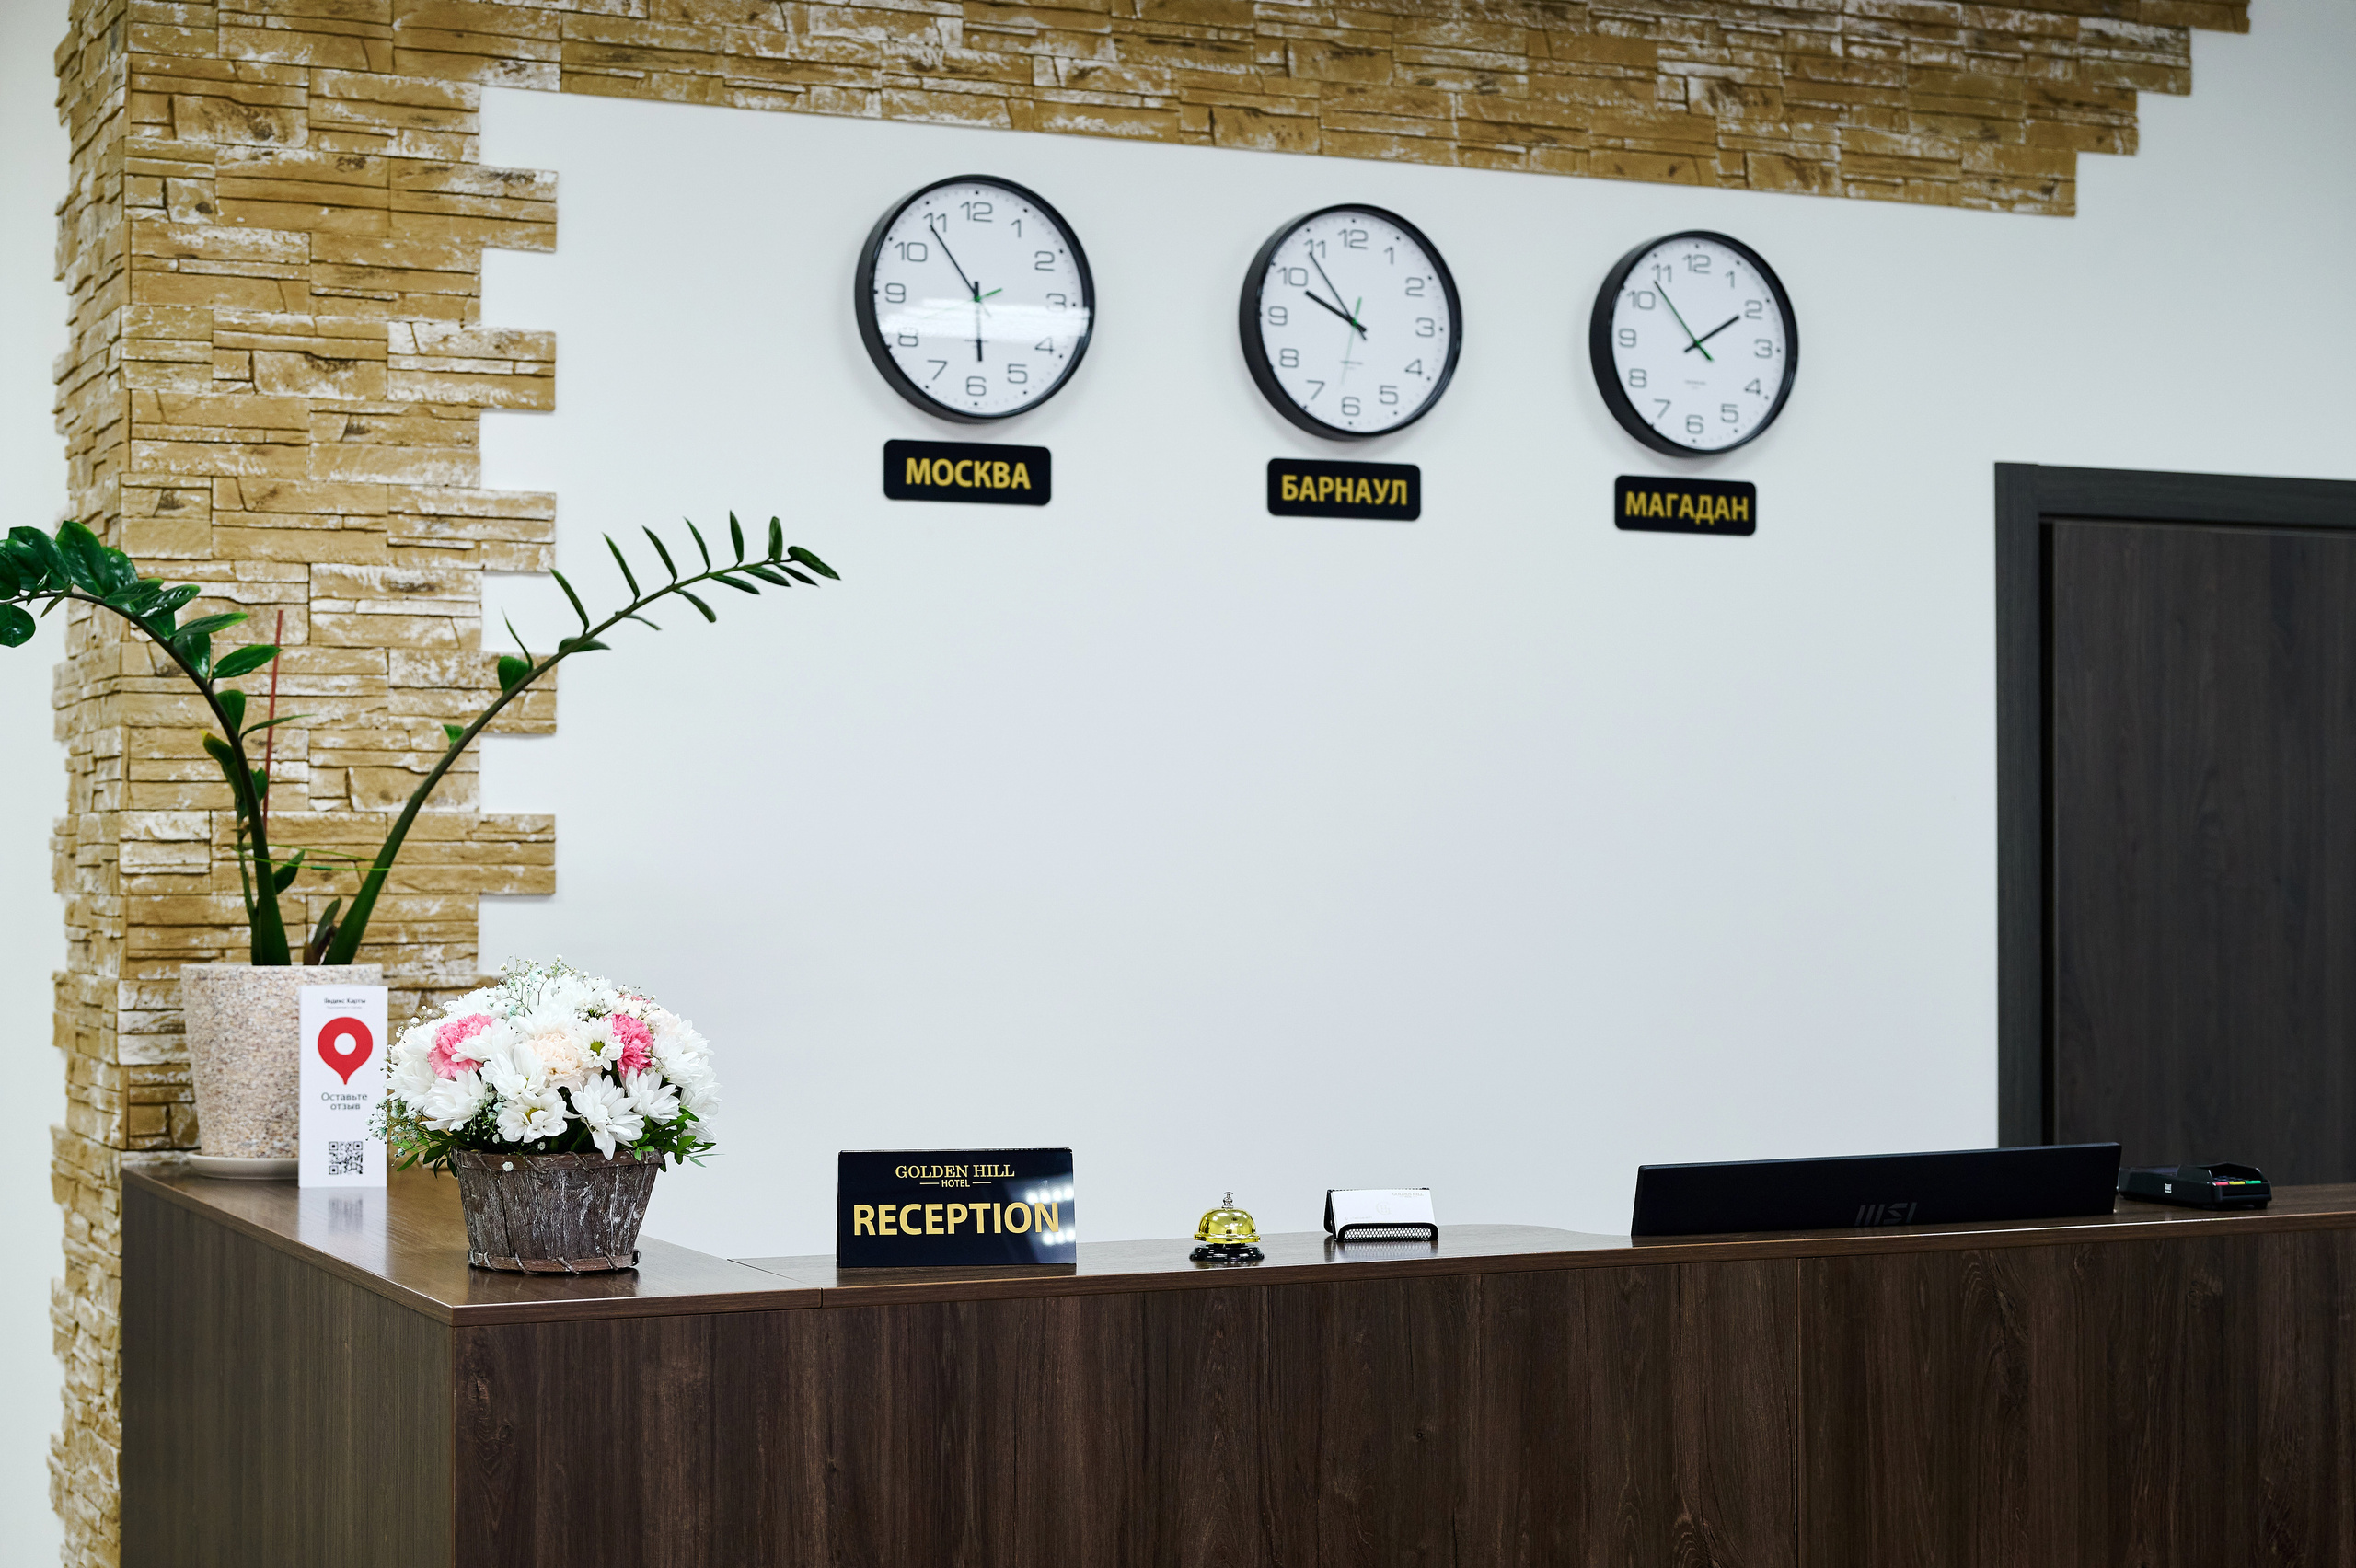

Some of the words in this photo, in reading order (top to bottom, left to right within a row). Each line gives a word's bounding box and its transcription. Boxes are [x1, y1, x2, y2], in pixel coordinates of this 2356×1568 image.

[923, 212, 947, 232] 11
[960, 202, 993, 223] 12
[1011, 219, 1022, 238] 1
[1304, 238, 1327, 259] 11
[1337, 229, 1369, 250] 12
[895, 242, 928, 262] 10
[1034, 251, 1056, 271] 2
[1384, 246, 1394, 265] 1
[1651, 263, 1672, 283] 11
[1682, 253, 1711, 274] 12
[1276, 267, 1309, 287] 10
[1405, 277, 1425, 297] 2
[1726, 270, 1735, 289] 1
[885, 283, 906, 304] 9
[1046, 293, 1067, 313] 3
[1626, 290, 1656, 310] 10
[1268, 306, 1288, 326] 9
[1745, 299, 1763, 320] 2
[897, 327, 918, 348] 8
[1415, 317, 1435, 338] 3
[1034, 336, 1055, 355] 4
[1618, 328, 1637, 349] 9
[1754, 339, 1773, 359] 3
[1279, 348, 1299, 368] 8
[1404, 358, 1423, 377] 4
[927, 360, 948, 381] 7
[1007, 363, 1028, 385] 5
[1628, 368, 1647, 388] 8
[966, 376, 987, 397] 6
[1306, 379, 1325, 400] 7
[1379, 385, 1399, 406] 5
[1744, 378, 1761, 396] 4
[1341, 396, 1361, 417] 6
[1654, 398, 1671, 419] 7
[1721, 403, 1739, 424] 5
[1686, 414, 1704, 435] 6
[906, 457, 1032, 490] МОСКВА
[1281, 474, 1408, 506] БАРНАУЛ
[1624, 490, 1749, 525] МАГАДАН
[321, 1092, 368, 1101] Оставьте
[895, 1164, 969, 1179] GOLDEN
[973, 1164, 1015, 1178] HILL
[941, 1179, 970, 1188] HOTEL
[853, 1202, 1059, 1236] RECEPTION
[1854, 1202, 1918, 1227] MSI
